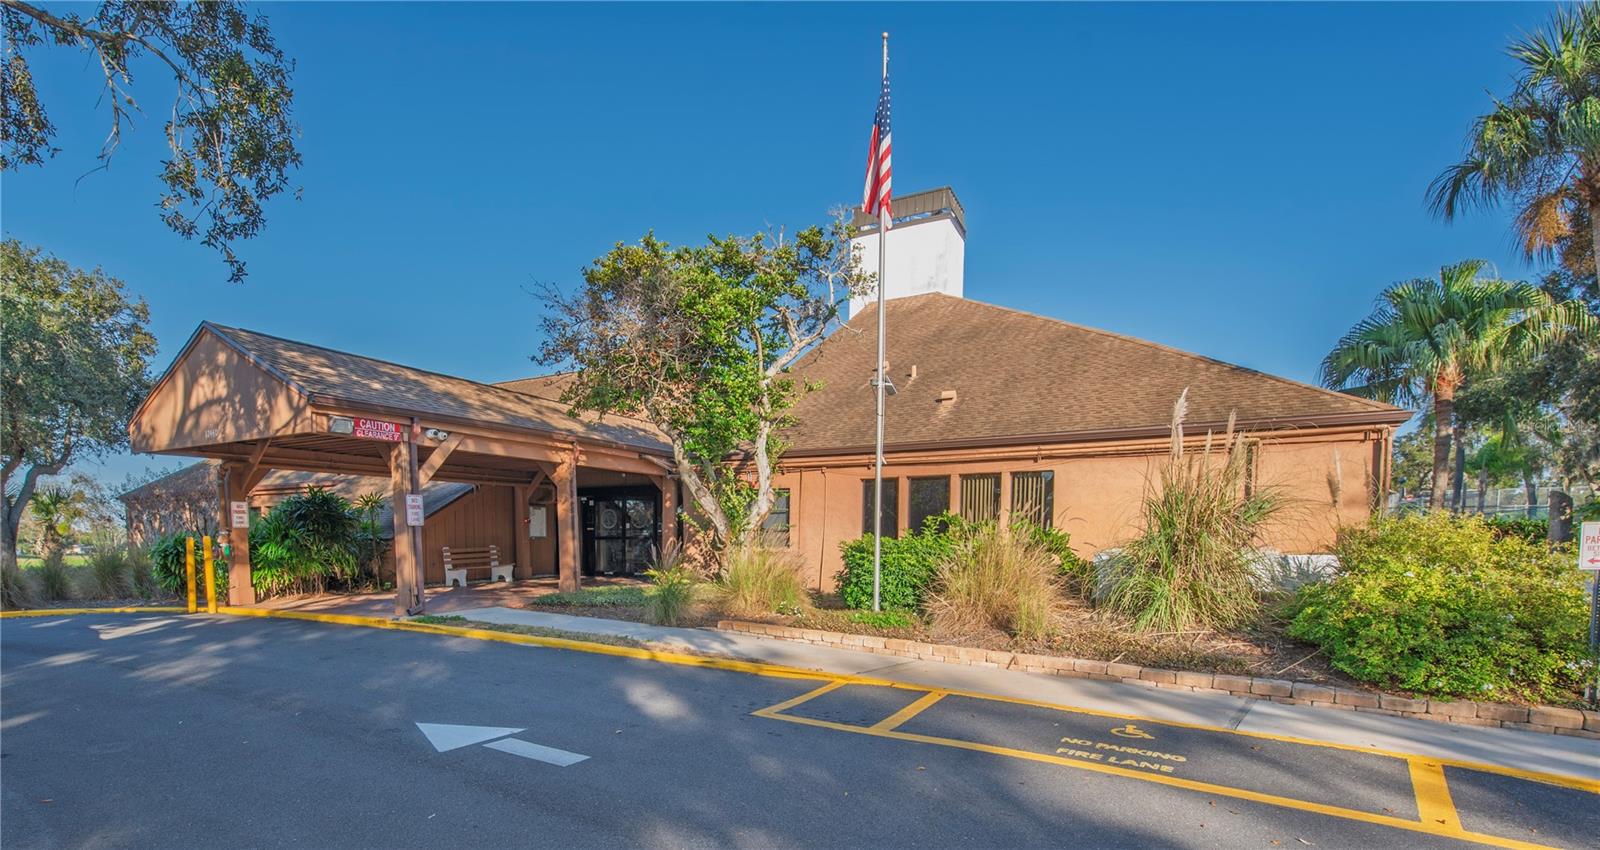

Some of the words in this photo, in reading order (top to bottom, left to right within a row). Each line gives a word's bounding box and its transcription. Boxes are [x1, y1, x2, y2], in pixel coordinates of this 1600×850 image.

[356, 429, 393, 440] CLEARANCE
[360, 419, 395, 432] CAUTION
[1060, 737, 1092, 746] NO
[1095, 742, 1187, 762] PARKING
[1056, 748, 1103, 760] FIRE
[1107, 756, 1175, 773] LANE
